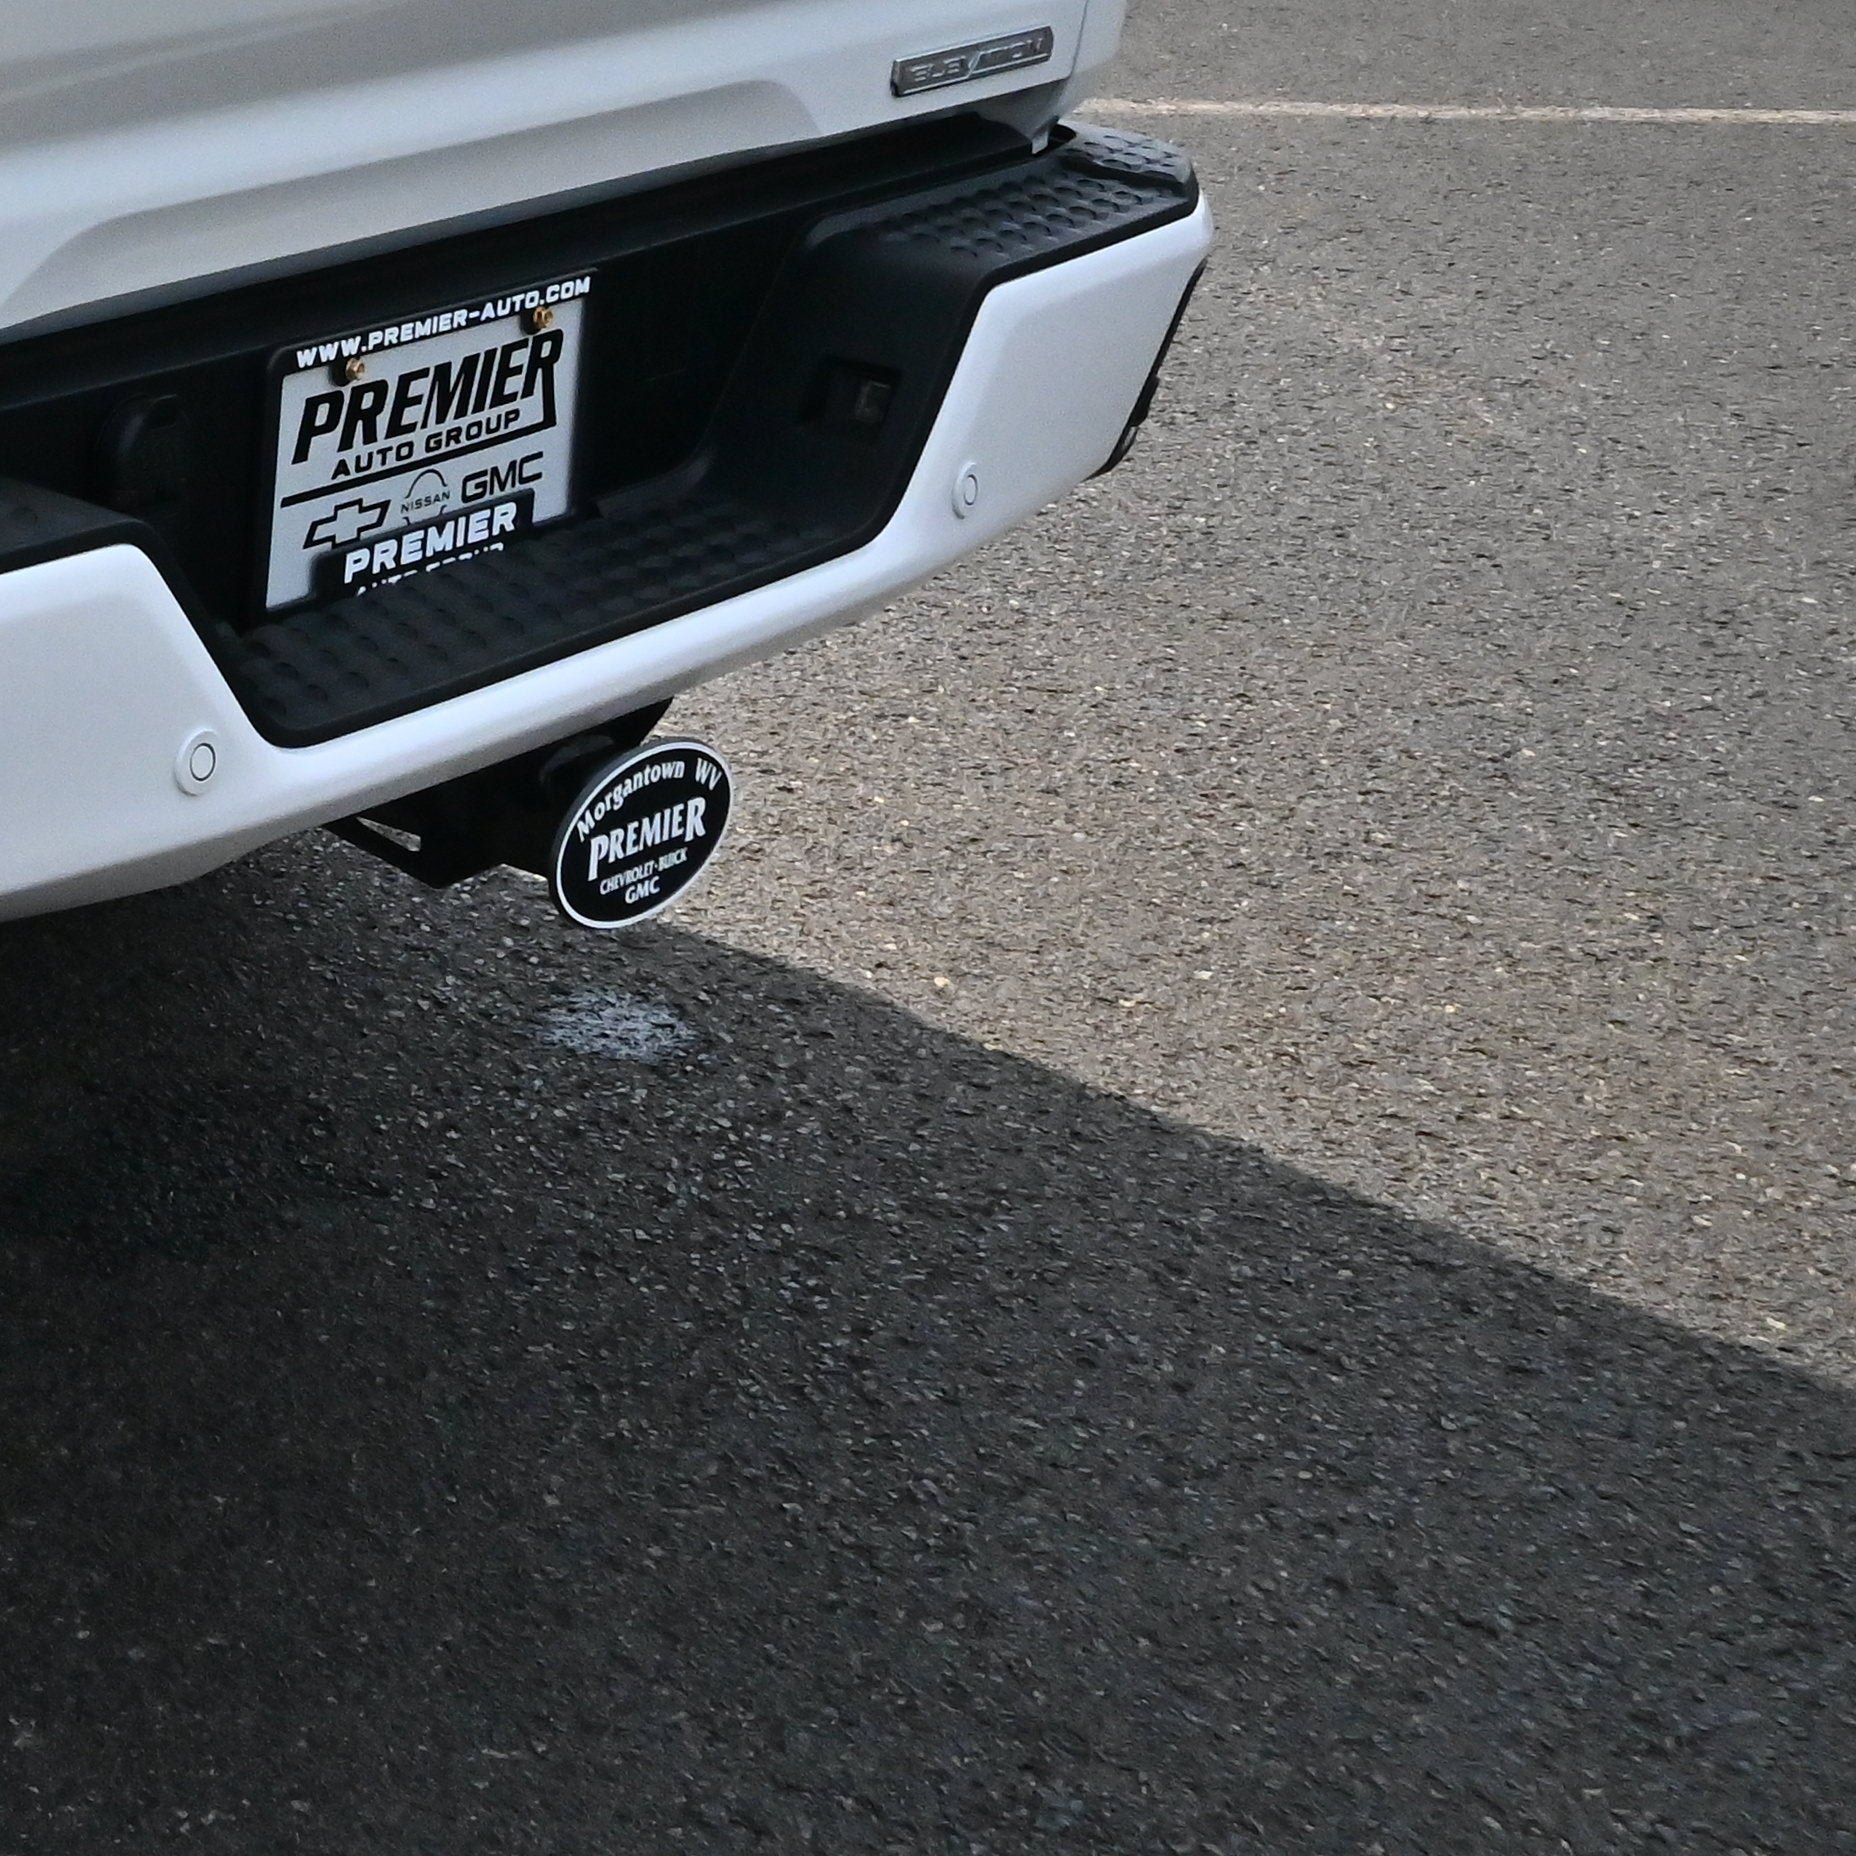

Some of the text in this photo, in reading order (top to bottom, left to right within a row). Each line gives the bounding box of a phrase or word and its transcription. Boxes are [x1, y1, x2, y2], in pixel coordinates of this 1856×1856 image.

[296, 276, 591, 369] WWW.PREMIER-AUTO.COM
[291, 328, 564, 464] PREMIER
[331, 408, 520, 480] AUTO GROUP
[460, 451, 544, 503] GMC
[343, 502, 517, 584] PREMIER
[400, 491, 451, 514] NISSAN
[575, 757, 723, 843] Morgantown WV
[587, 797, 707, 882] PREMIER
[624, 876, 661, 904] GMC
